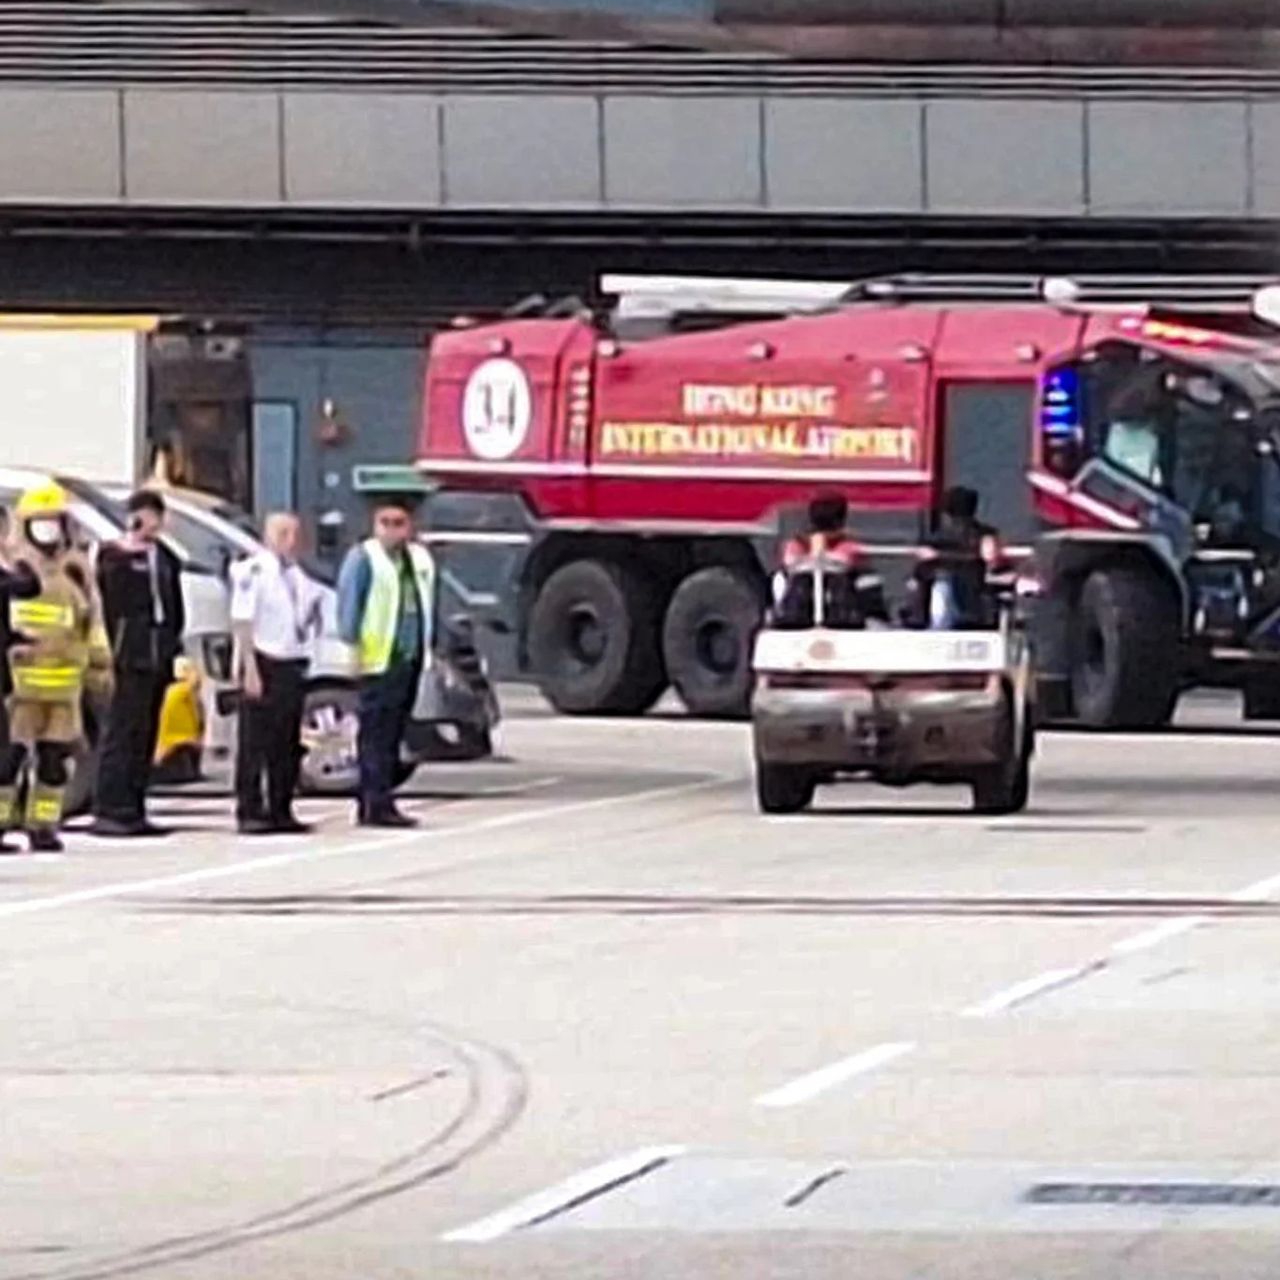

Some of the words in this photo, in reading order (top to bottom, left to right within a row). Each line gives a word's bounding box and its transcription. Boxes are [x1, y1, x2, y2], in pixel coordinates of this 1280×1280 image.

[682, 383, 757, 416] HONG
[759, 384, 837, 417] KONG
[601, 421, 804, 455] INTERNATIONAL
[805, 424, 916, 461] AIRPORT
